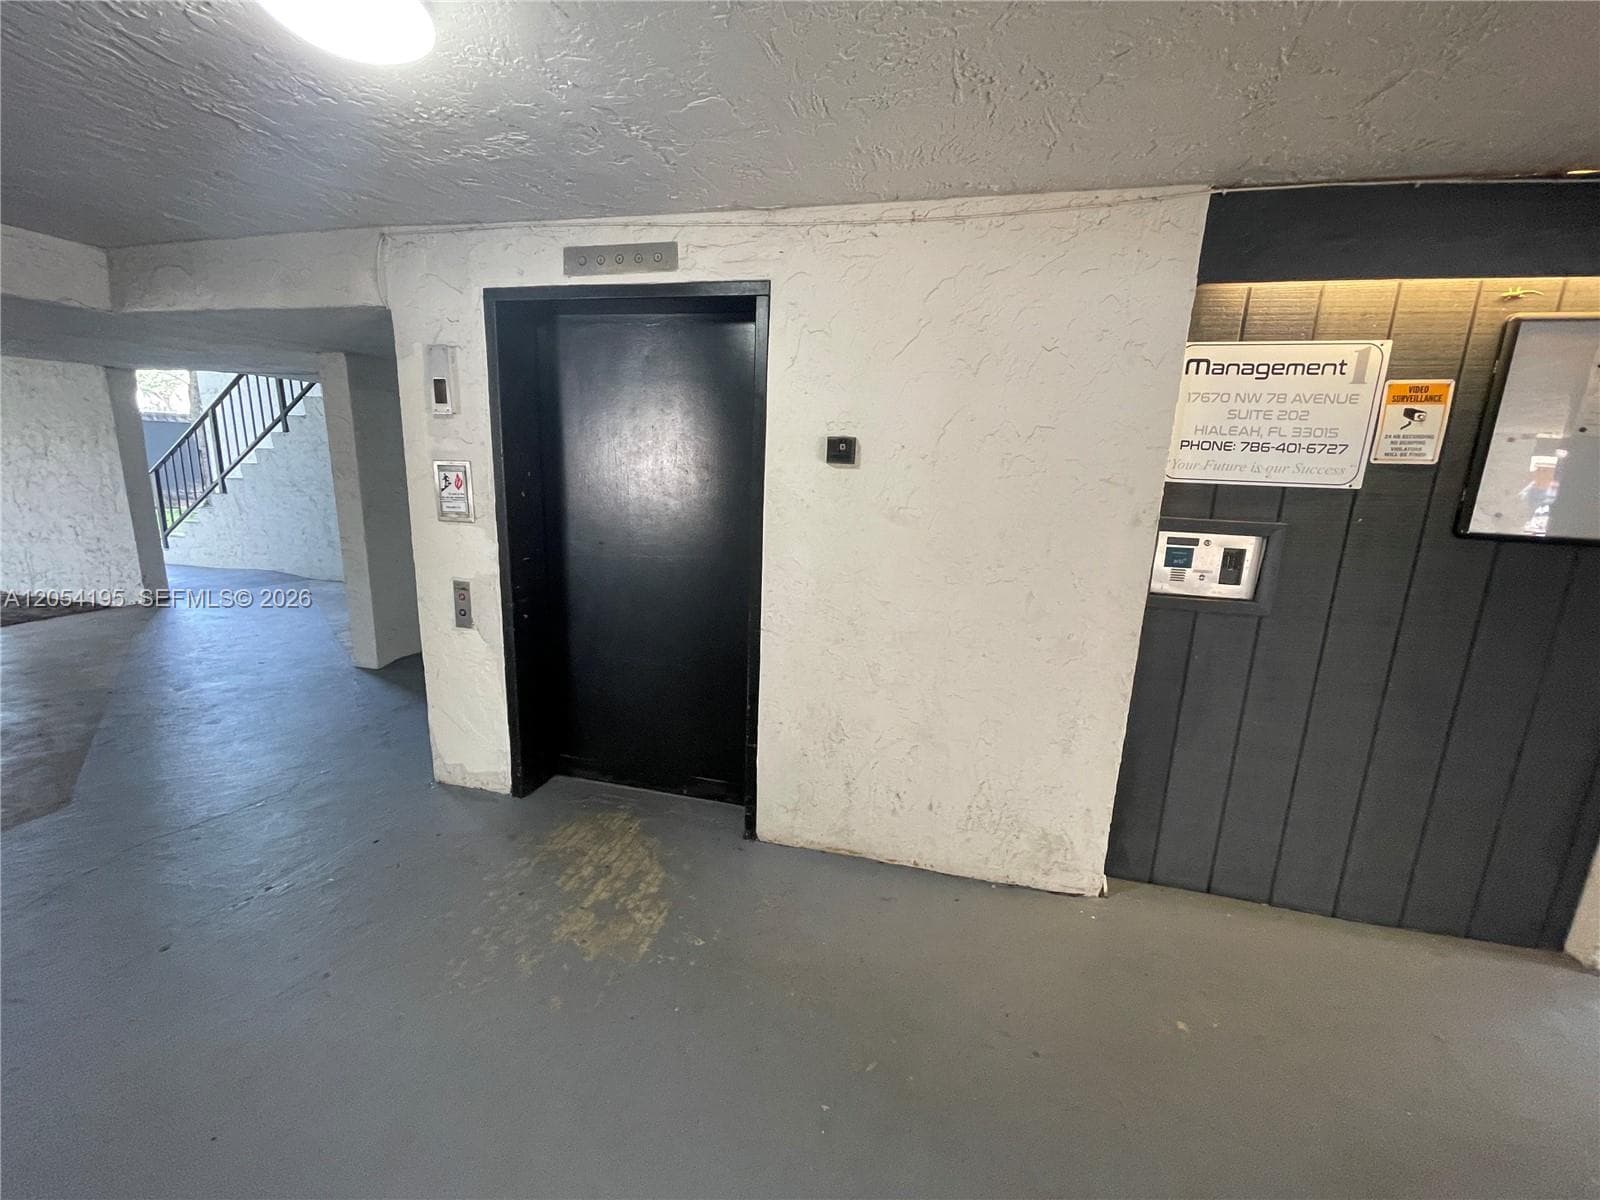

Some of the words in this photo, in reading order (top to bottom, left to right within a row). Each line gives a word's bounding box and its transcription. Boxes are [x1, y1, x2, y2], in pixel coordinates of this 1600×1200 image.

[1185, 358, 1348, 380] Management
[1408, 385, 1430, 394] VIDEO
[1187, 392, 1231, 404] 17670
[1234, 392, 1263, 404] NW
[1266, 393, 1288, 404] 78
[1290, 393, 1360, 405] AVENUE
[1391, 394, 1443, 403] SURVEILLANCE
[1226, 409, 1274, 421] SUITE
[1276, 409, 1310, 421] 202
[1193, 425, 1264, 439] HIALEAH,
[1267, 426, 1288, 438] FL
[1290, 427, 1340, 438] 33015
[1179, 440, 1236, 452] PHONE:
[1240, 441, 1349, 455] 786-401-6727
[1203, 459, 1247, 472] Future
[1250, 461, 1262, 474] is
[1265, 463, 1289, 474] our
